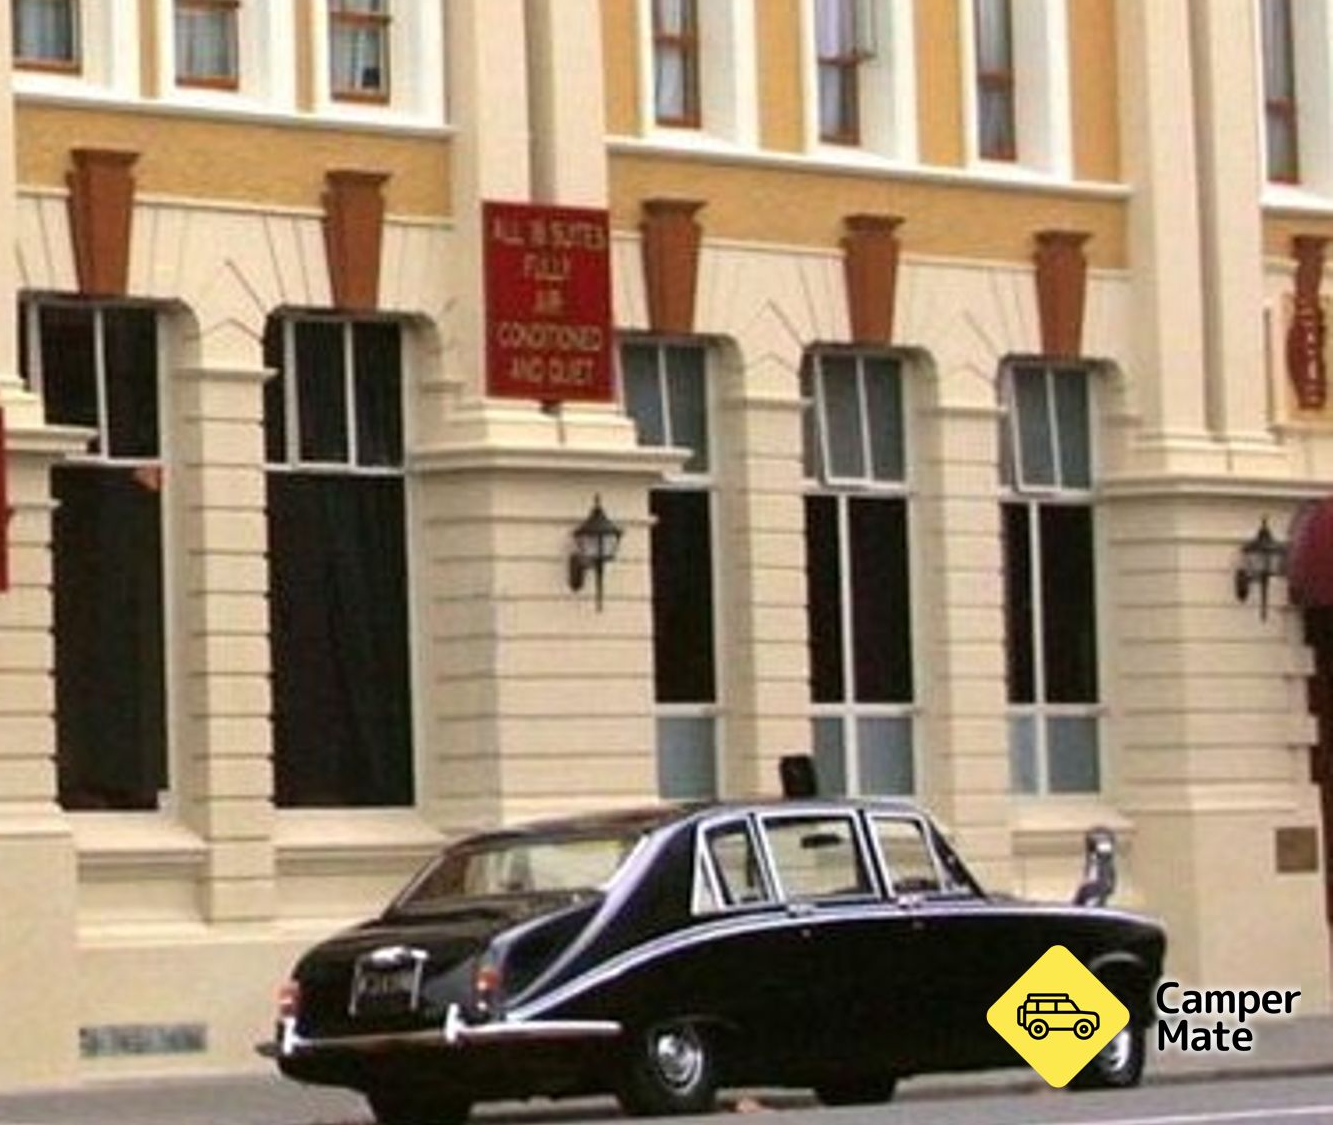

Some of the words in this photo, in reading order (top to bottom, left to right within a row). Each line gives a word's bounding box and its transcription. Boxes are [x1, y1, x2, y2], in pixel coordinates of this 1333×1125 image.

[490, 217, 525, 245] ALL
[524, 253, 572, 281] FULLY
[496, 321, 604, 352] CONDITIONED
[508, 356, 544, 383] AND
[548, 356, 596, 386] QUIET
